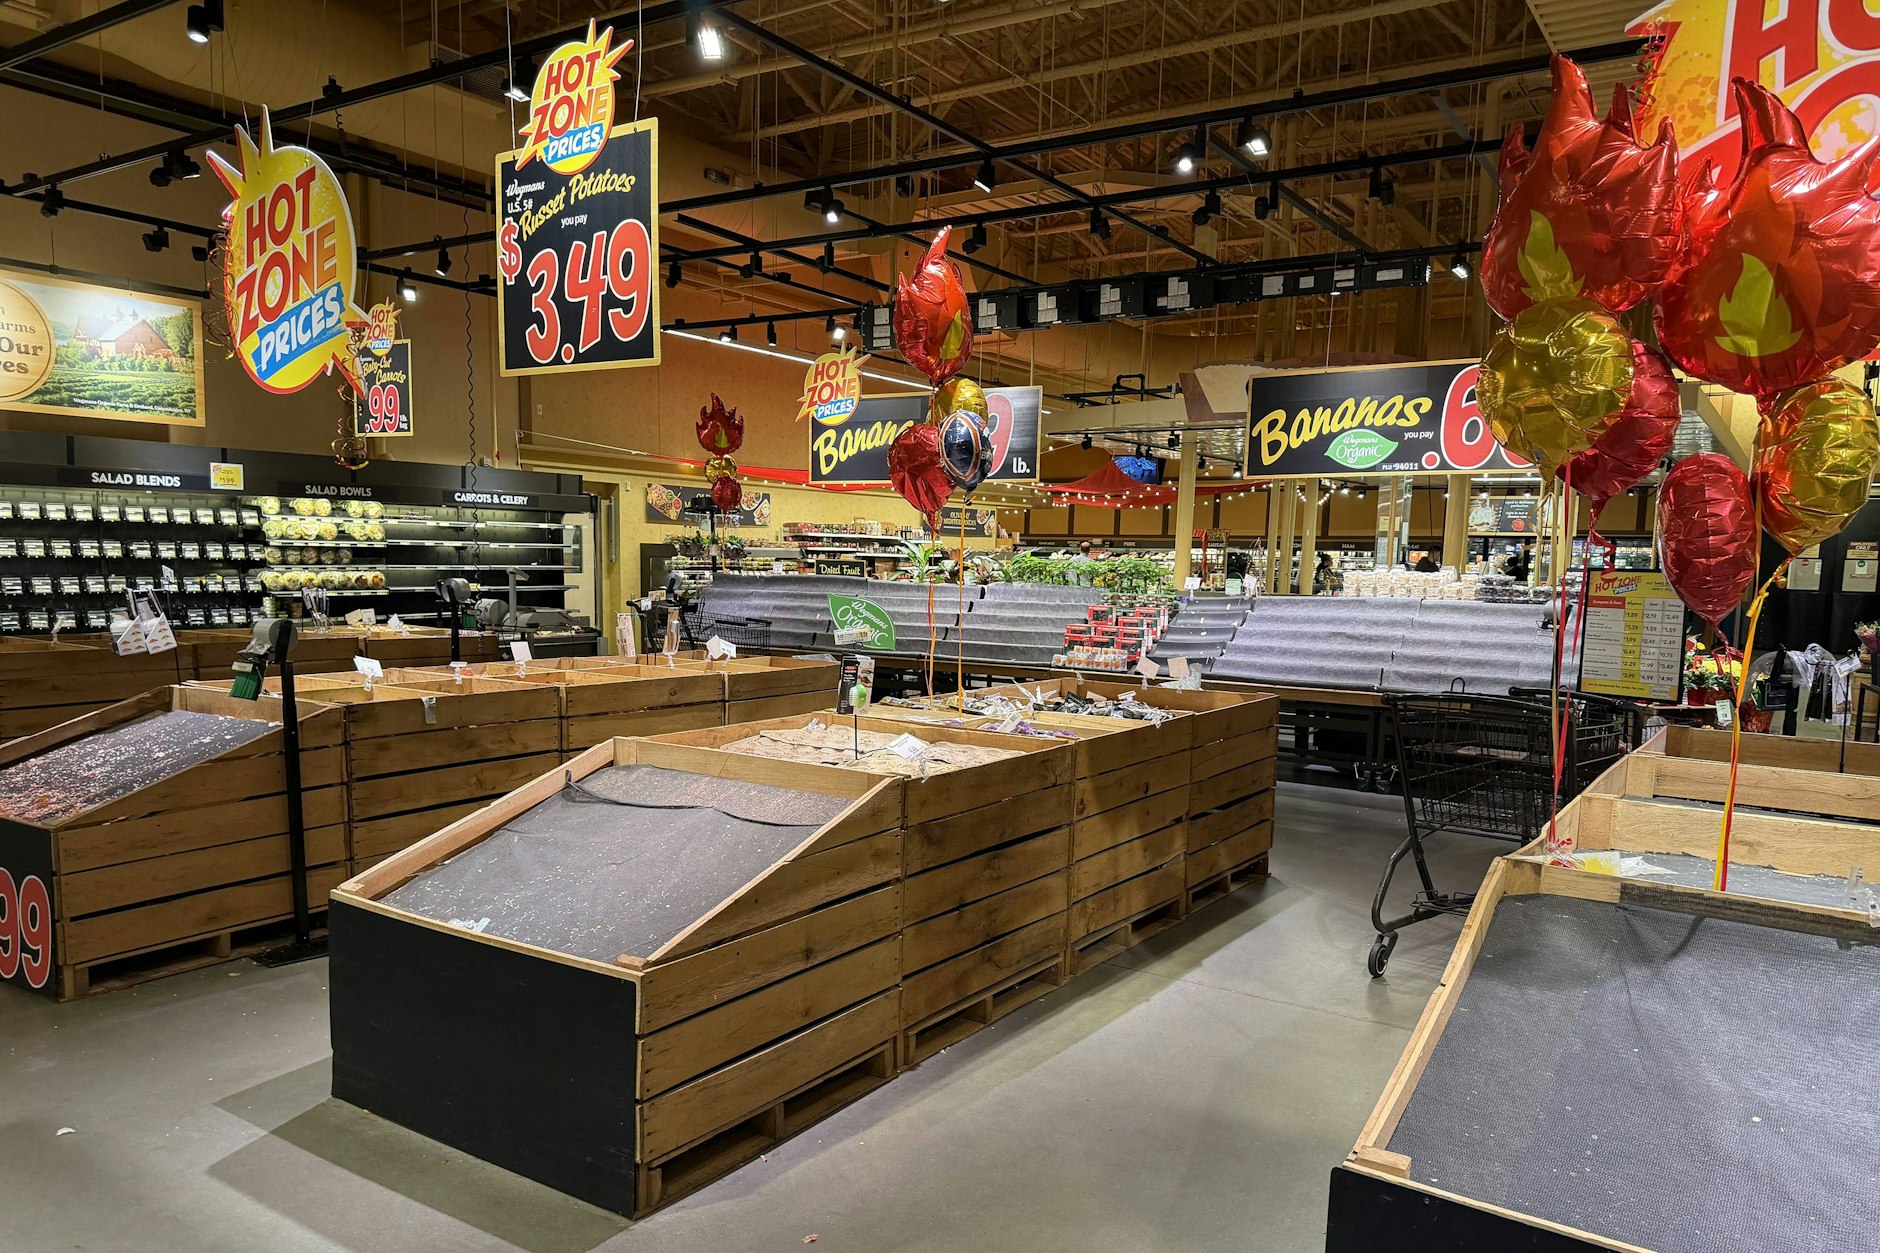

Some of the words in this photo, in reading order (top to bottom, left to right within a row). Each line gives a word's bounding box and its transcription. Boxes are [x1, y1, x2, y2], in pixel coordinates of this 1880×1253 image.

[543, 49, 601, 100] HOT
[531, 85, 609, 145] ZONE
[547, 128, 602, 162] PRICES
[505, 179, 545, 201] Wegmans
[507, 201, 522, 213] U.S.
[523, 199, 533, 211] 5#
[519, 186, 567, 242] Russet
[569, 168, 636, 205] Potatoes
[245, 166, 318, 268] HOT
[561, 216, 574, 229] you
[575, 214, 588, 227] pay
[235, 214, 337, 343] ZONE
[371, 309, 391, 323] HOT
[258, 285, 342, 372] PRICES
[367, 323, 394, 340] ZONE
[0, 336, 43, 357] Our
[371, 338, 391, 350] PRICES
[363, 356, 393, 376] Baby-Cut
[813, 357, 851, 384] HOT
[375, 369, 406, 385] Carrots
[807, 377, 857, 408] ZONE
[365, 384, 400, 432] .99
[816, 398, 853, 419] PRICES
[1252, 394, 1433, 466] Bananas
[1404, 431, 1418, 440] you
[1420, 430, 1434, 440] pay
[1343, 434, 1379, 447] Wegmans
[1012, 457, 1031, 474] lb.
[91, 472, 133, 485] SALAD
[136, 474, 181, 487] BLENDS
[305, 485, 337, 496] SALAD
[340, 486, 372, 497] BOWLS
[454, 492, 492, 503] CARROTS
[493, 494, 499, 503] &
[501, 495, 528, 505] CELERY
[820, 564, 840, 575] Dried
[842, 565, 861, 575] Fruit
[1595, 578, 1616, 593] HOT
[1618, 575, 1642, 587] ZONE
[1615, 584, 1637, 594] PRICES
[851, 601, 888, 629] Wegmans
